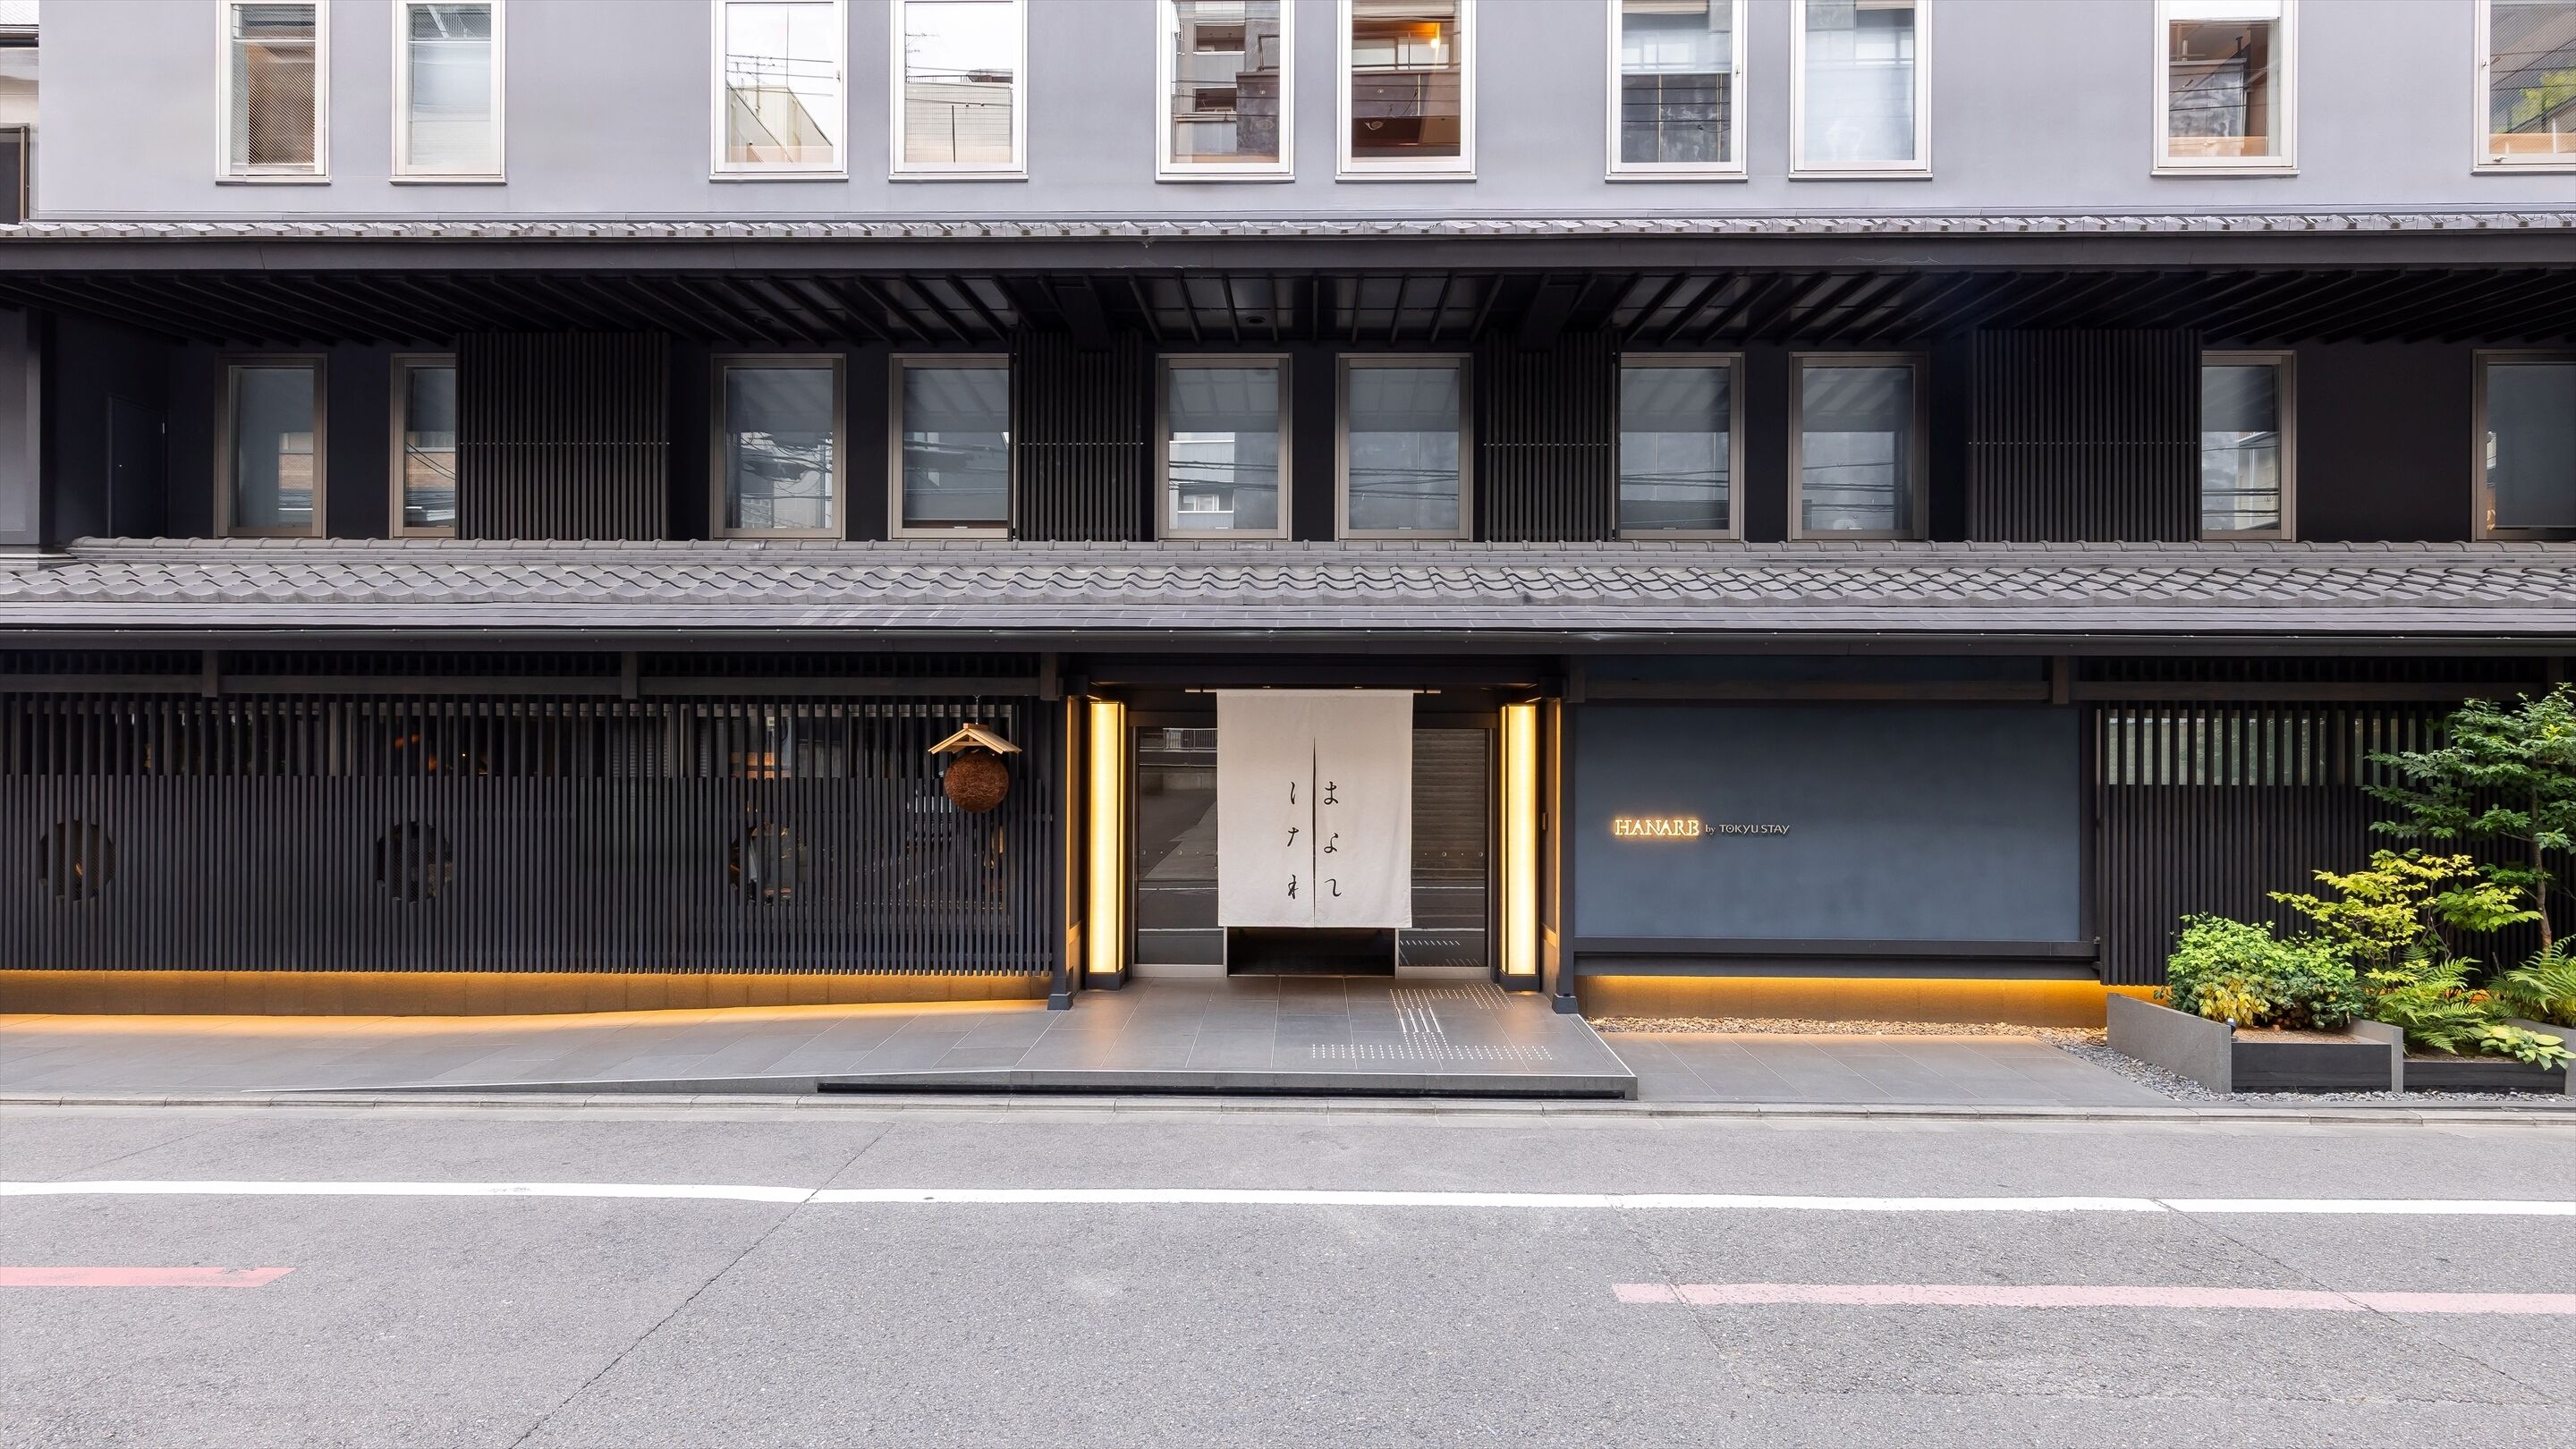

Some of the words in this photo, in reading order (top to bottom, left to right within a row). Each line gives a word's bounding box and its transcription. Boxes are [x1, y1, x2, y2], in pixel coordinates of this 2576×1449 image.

[1705, 824, 1716, 835] by
[1719, 824, 1758, 835] TOKYU
[1761, 824, 1790, 835] STAY
